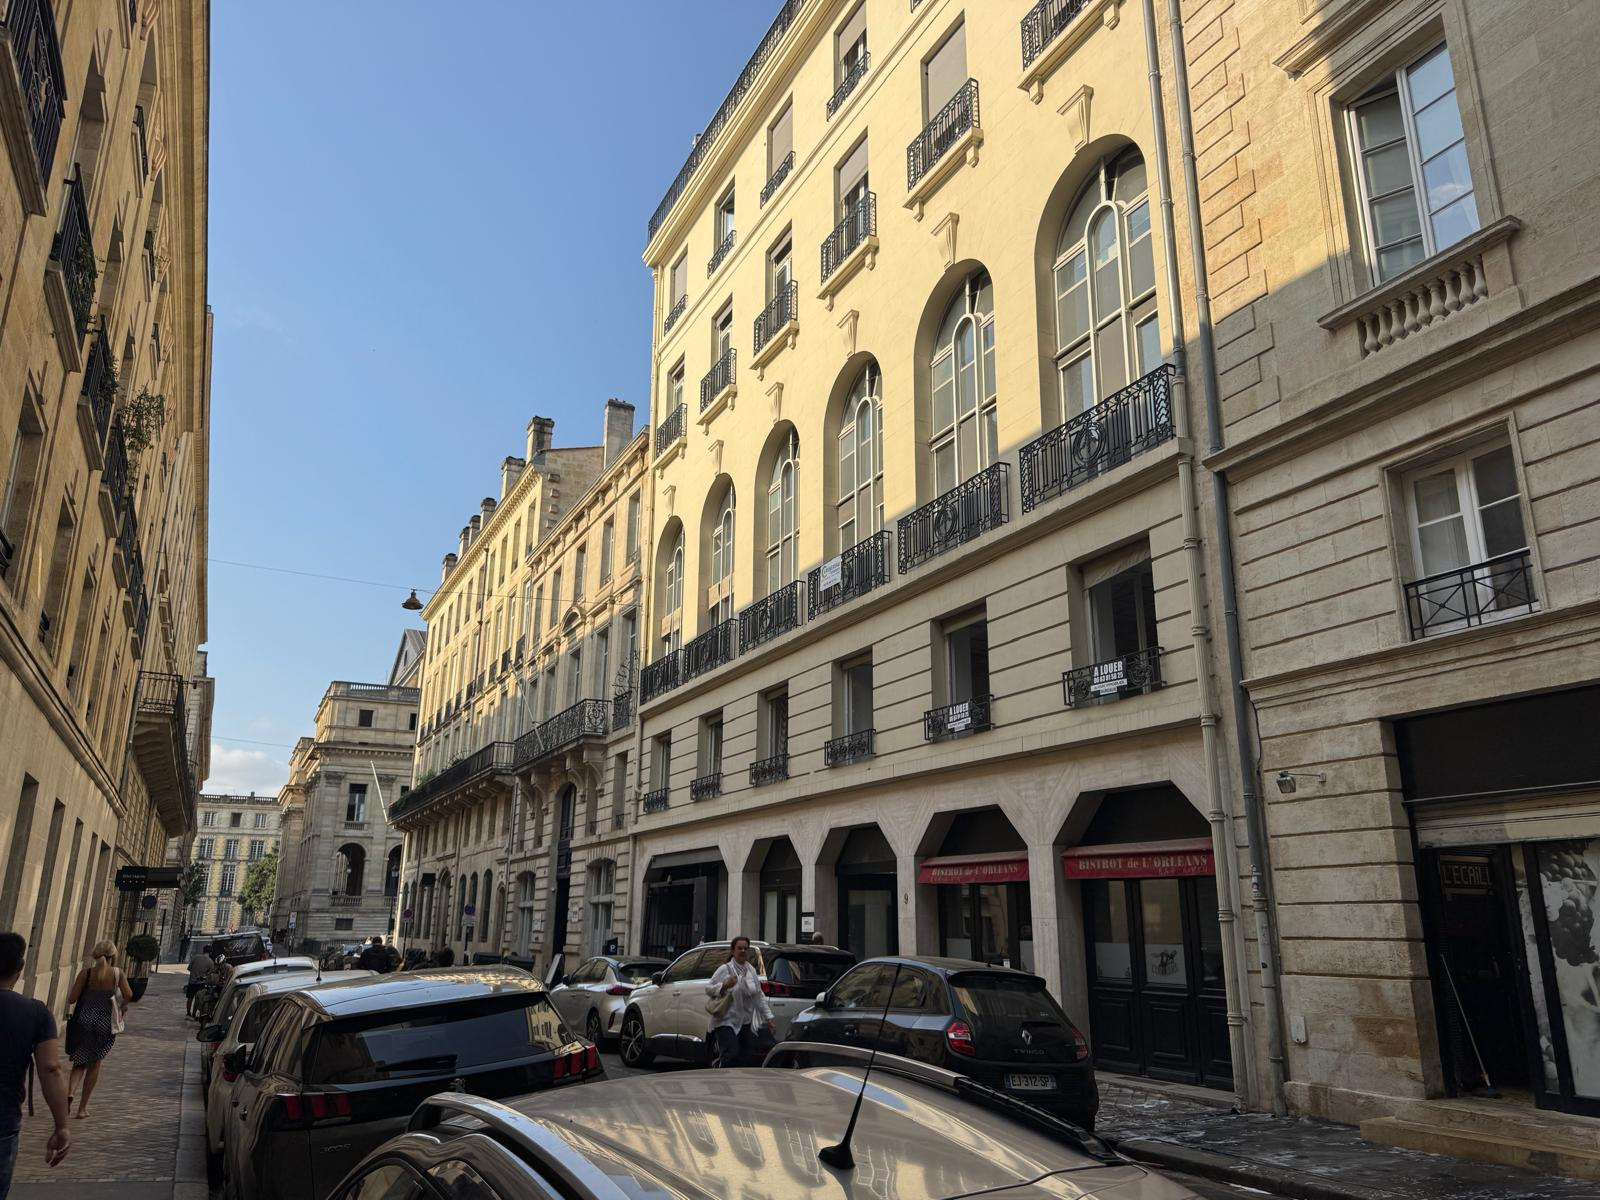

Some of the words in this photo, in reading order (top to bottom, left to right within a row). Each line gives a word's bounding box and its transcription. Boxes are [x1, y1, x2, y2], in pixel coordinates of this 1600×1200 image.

[1093, 666, 1099, 677] A
[1100, 661, 1123, 675] LOUER
[949, 706, 953, 716] A
[953, 702, 969, 714] LOUER
[1079, 858, 1123, 870] BISTROT
[1127, 857, 1139, 868] de
[931, 866, 963, 876] BISTROT
[903, 892, 909, 905] 9
